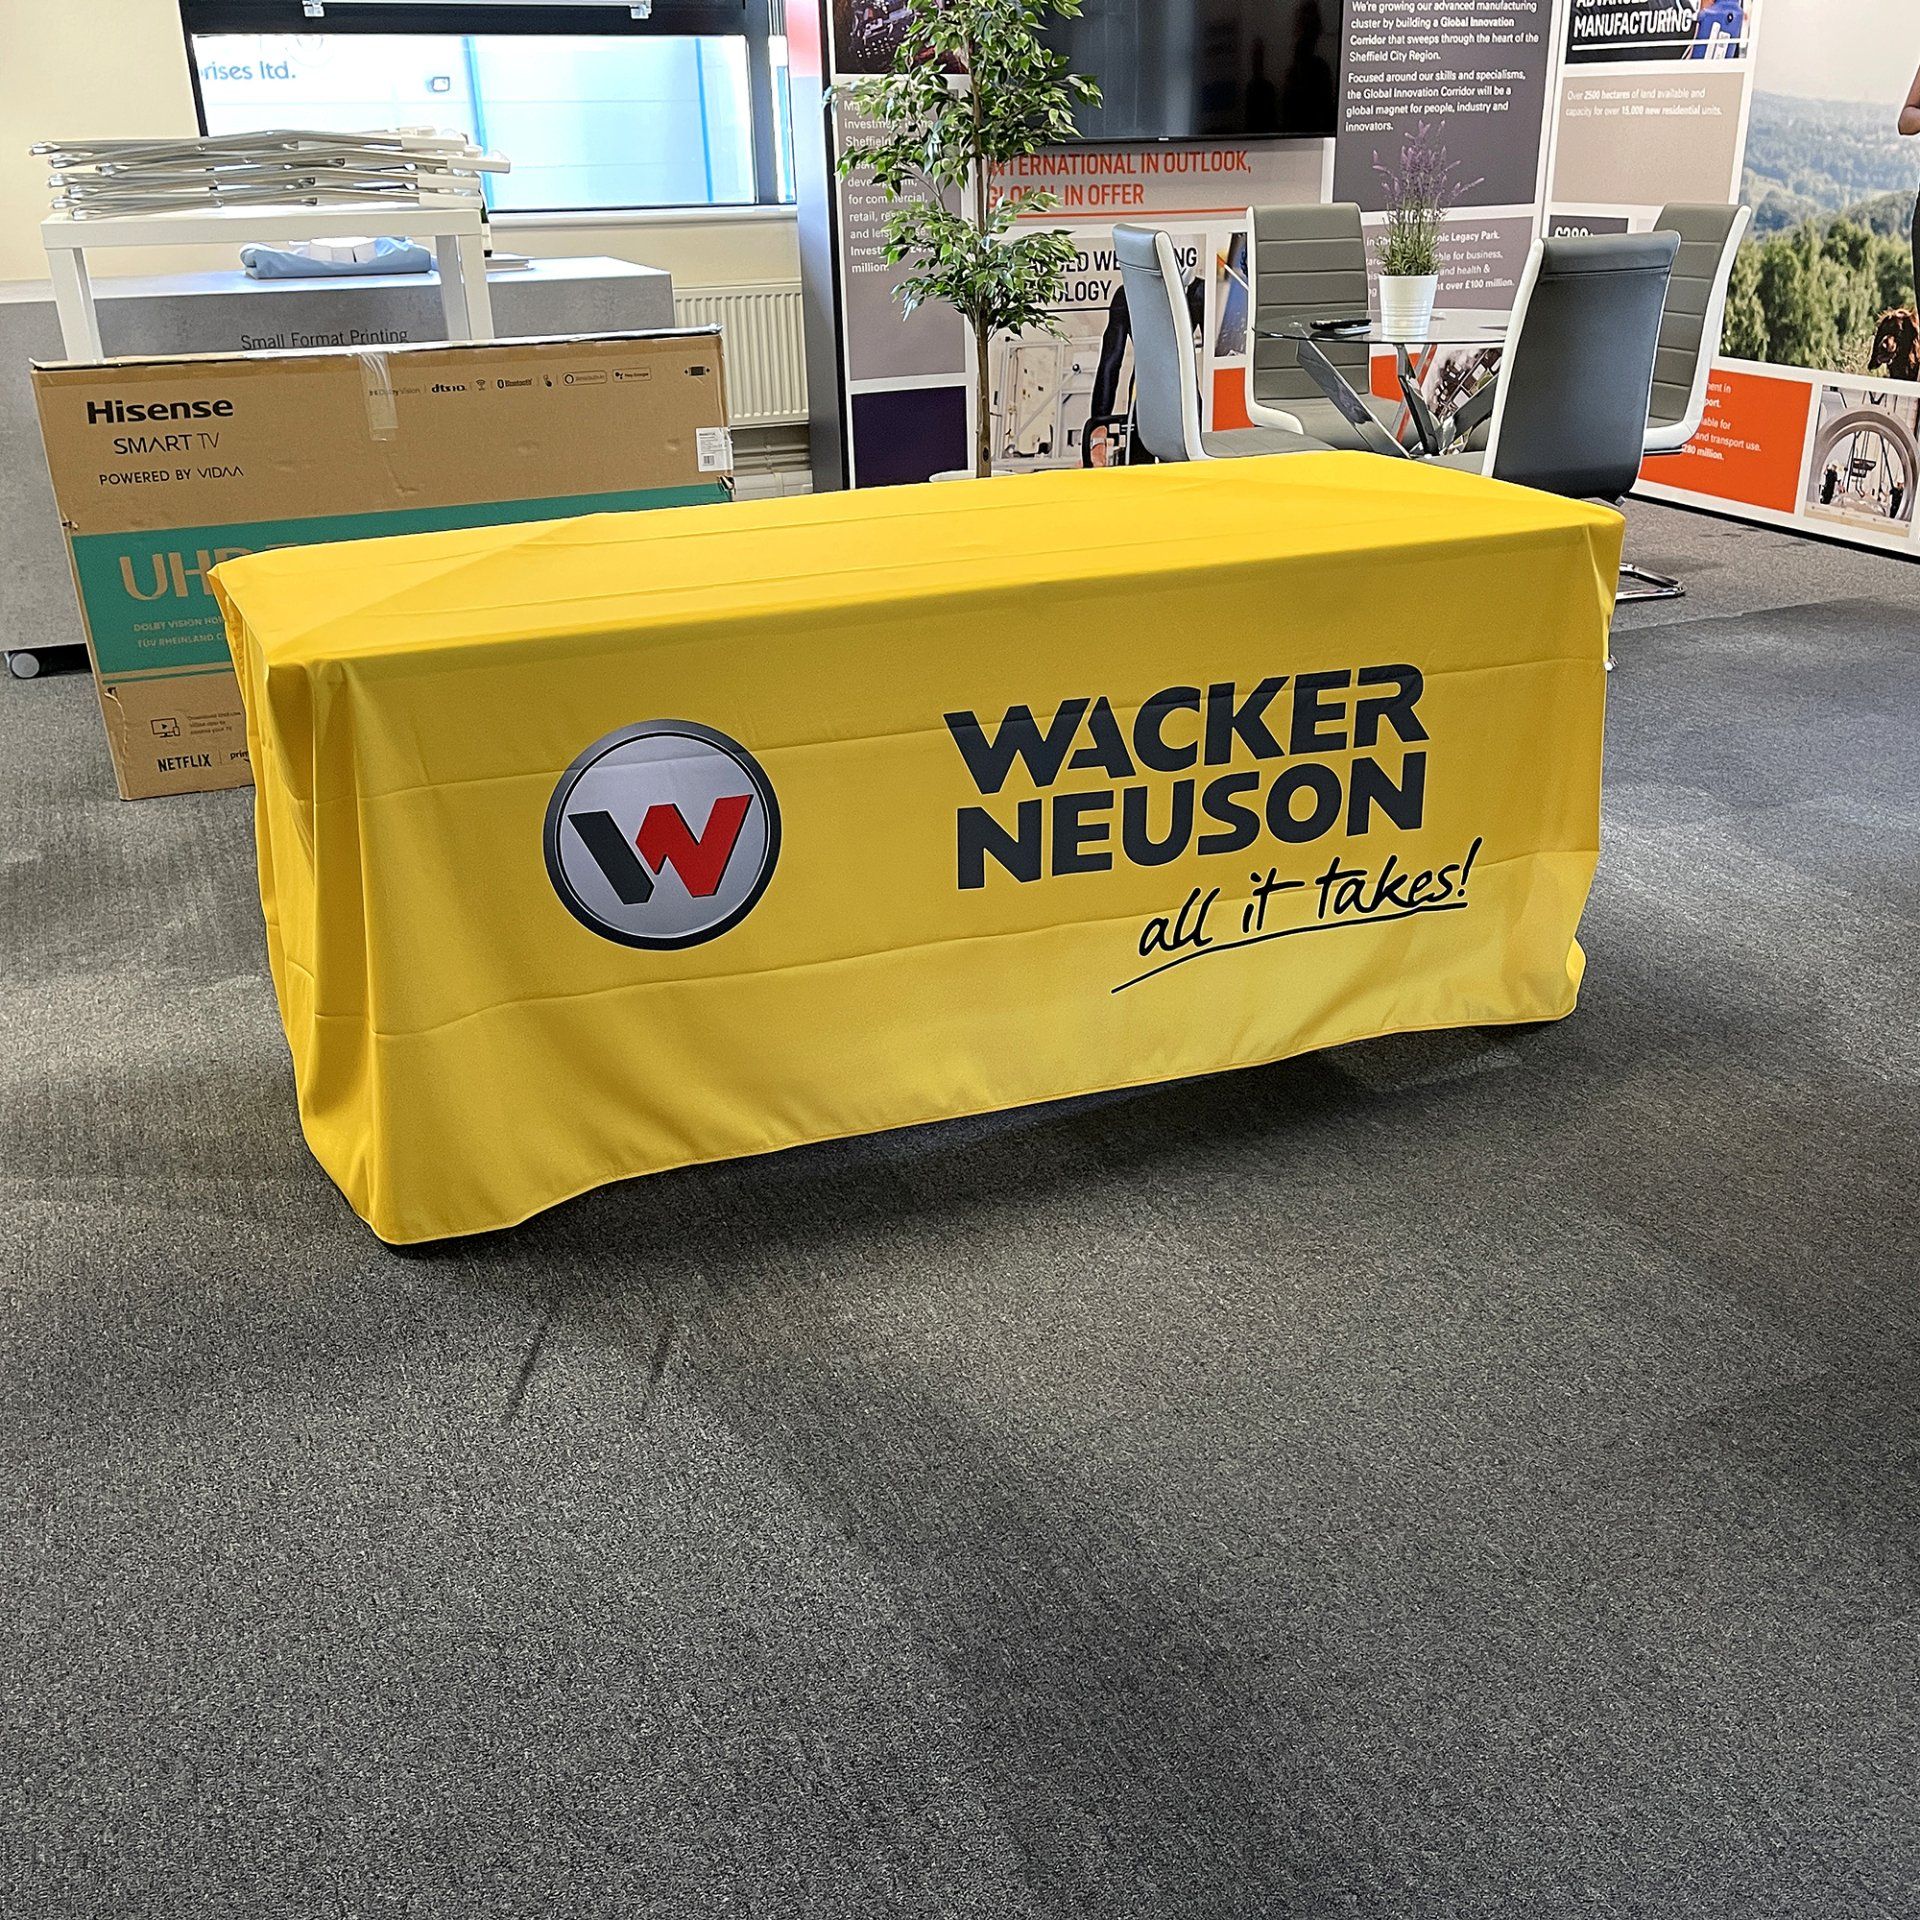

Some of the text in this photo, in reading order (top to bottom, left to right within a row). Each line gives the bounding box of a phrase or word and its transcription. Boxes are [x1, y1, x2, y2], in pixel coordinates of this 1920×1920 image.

[1379, 1, 1415, 14] growing
[1417, 2, 1433, 11] our
[1434, 0, 1475, 11] advanced
[1477, 0, 1537, 13] manufacturing
[1351, 18, 1380, 29] cluster
[1382, 18, 1394, 30] by
[1396, 16, 1431, 29] building
[1440, 16, 1469, 28] Global
[1470, 16, 1515, 27] Innovation
[1573, 8, 1693, 38] MANUFACTURING
[1350, 32, 1539, 47] Corridor that sweeps through the heart of the
[1349, 50, 1441, 63] Sheffield City Region.
[201, 61, 253, 80] rises
[1348, 70, 1526, 83] Focused around our skills and specialisms,
[1347, 89, 1361, 99] the
[1363, 88, 1392, 99] Global
[1393, 86, 1439, 98] Innovation
[1440, 86, 1476, 97] Corridor
[1477, 85, 1492, 96] will
[1493, 85, 1505, 95] be
[1346, 101, 1509, 118] global magnet for people, industry and
[1345, 121, 1394, 132] innovators.
[1141, 152, 1159, 174] IN
[1163, 150, 1252, 174] OUTLOOK,
[848, 193, 863, 205] for
[1064, 184, 1083, 206] IN
[1087, 183, 1145, 206] OFFER
[849, 211, 878, 222] retail,
[850, 229, 870, 239] and
[1451, 231, 1480, 244] Legacy
[1452, 251, 1464, 261] for
[1456, 264, 1482, 275] health
[1483, 263, 1491, 274] &
[1445, 280, 1464, 290] over
[1464, 278, 1485, 290] £100
[1485, 277, 1515, 288] million.
[240, 327, 408, 350] Small Format Printing
[87, 399, 234, 425] Hisense
[1720, 419, 1731, 430] for
[113, 431, 220, 455] SMART TV
[1695, 432, 1710, 442] and
[1710, 435, 1746, 448] transport
[99, 465, 244, 486] POWERED BY VIDAA
[133, 621, 166, 632] DOLBY
[167, 618, 202, 629] VISION
[943, 664, 1430, 795] WACKER
[157, 754, 212, 773] NETFLIX
[957, 751, 1427, 891] NEUSON
[1139, 836, 1483, 957] all it takes!
